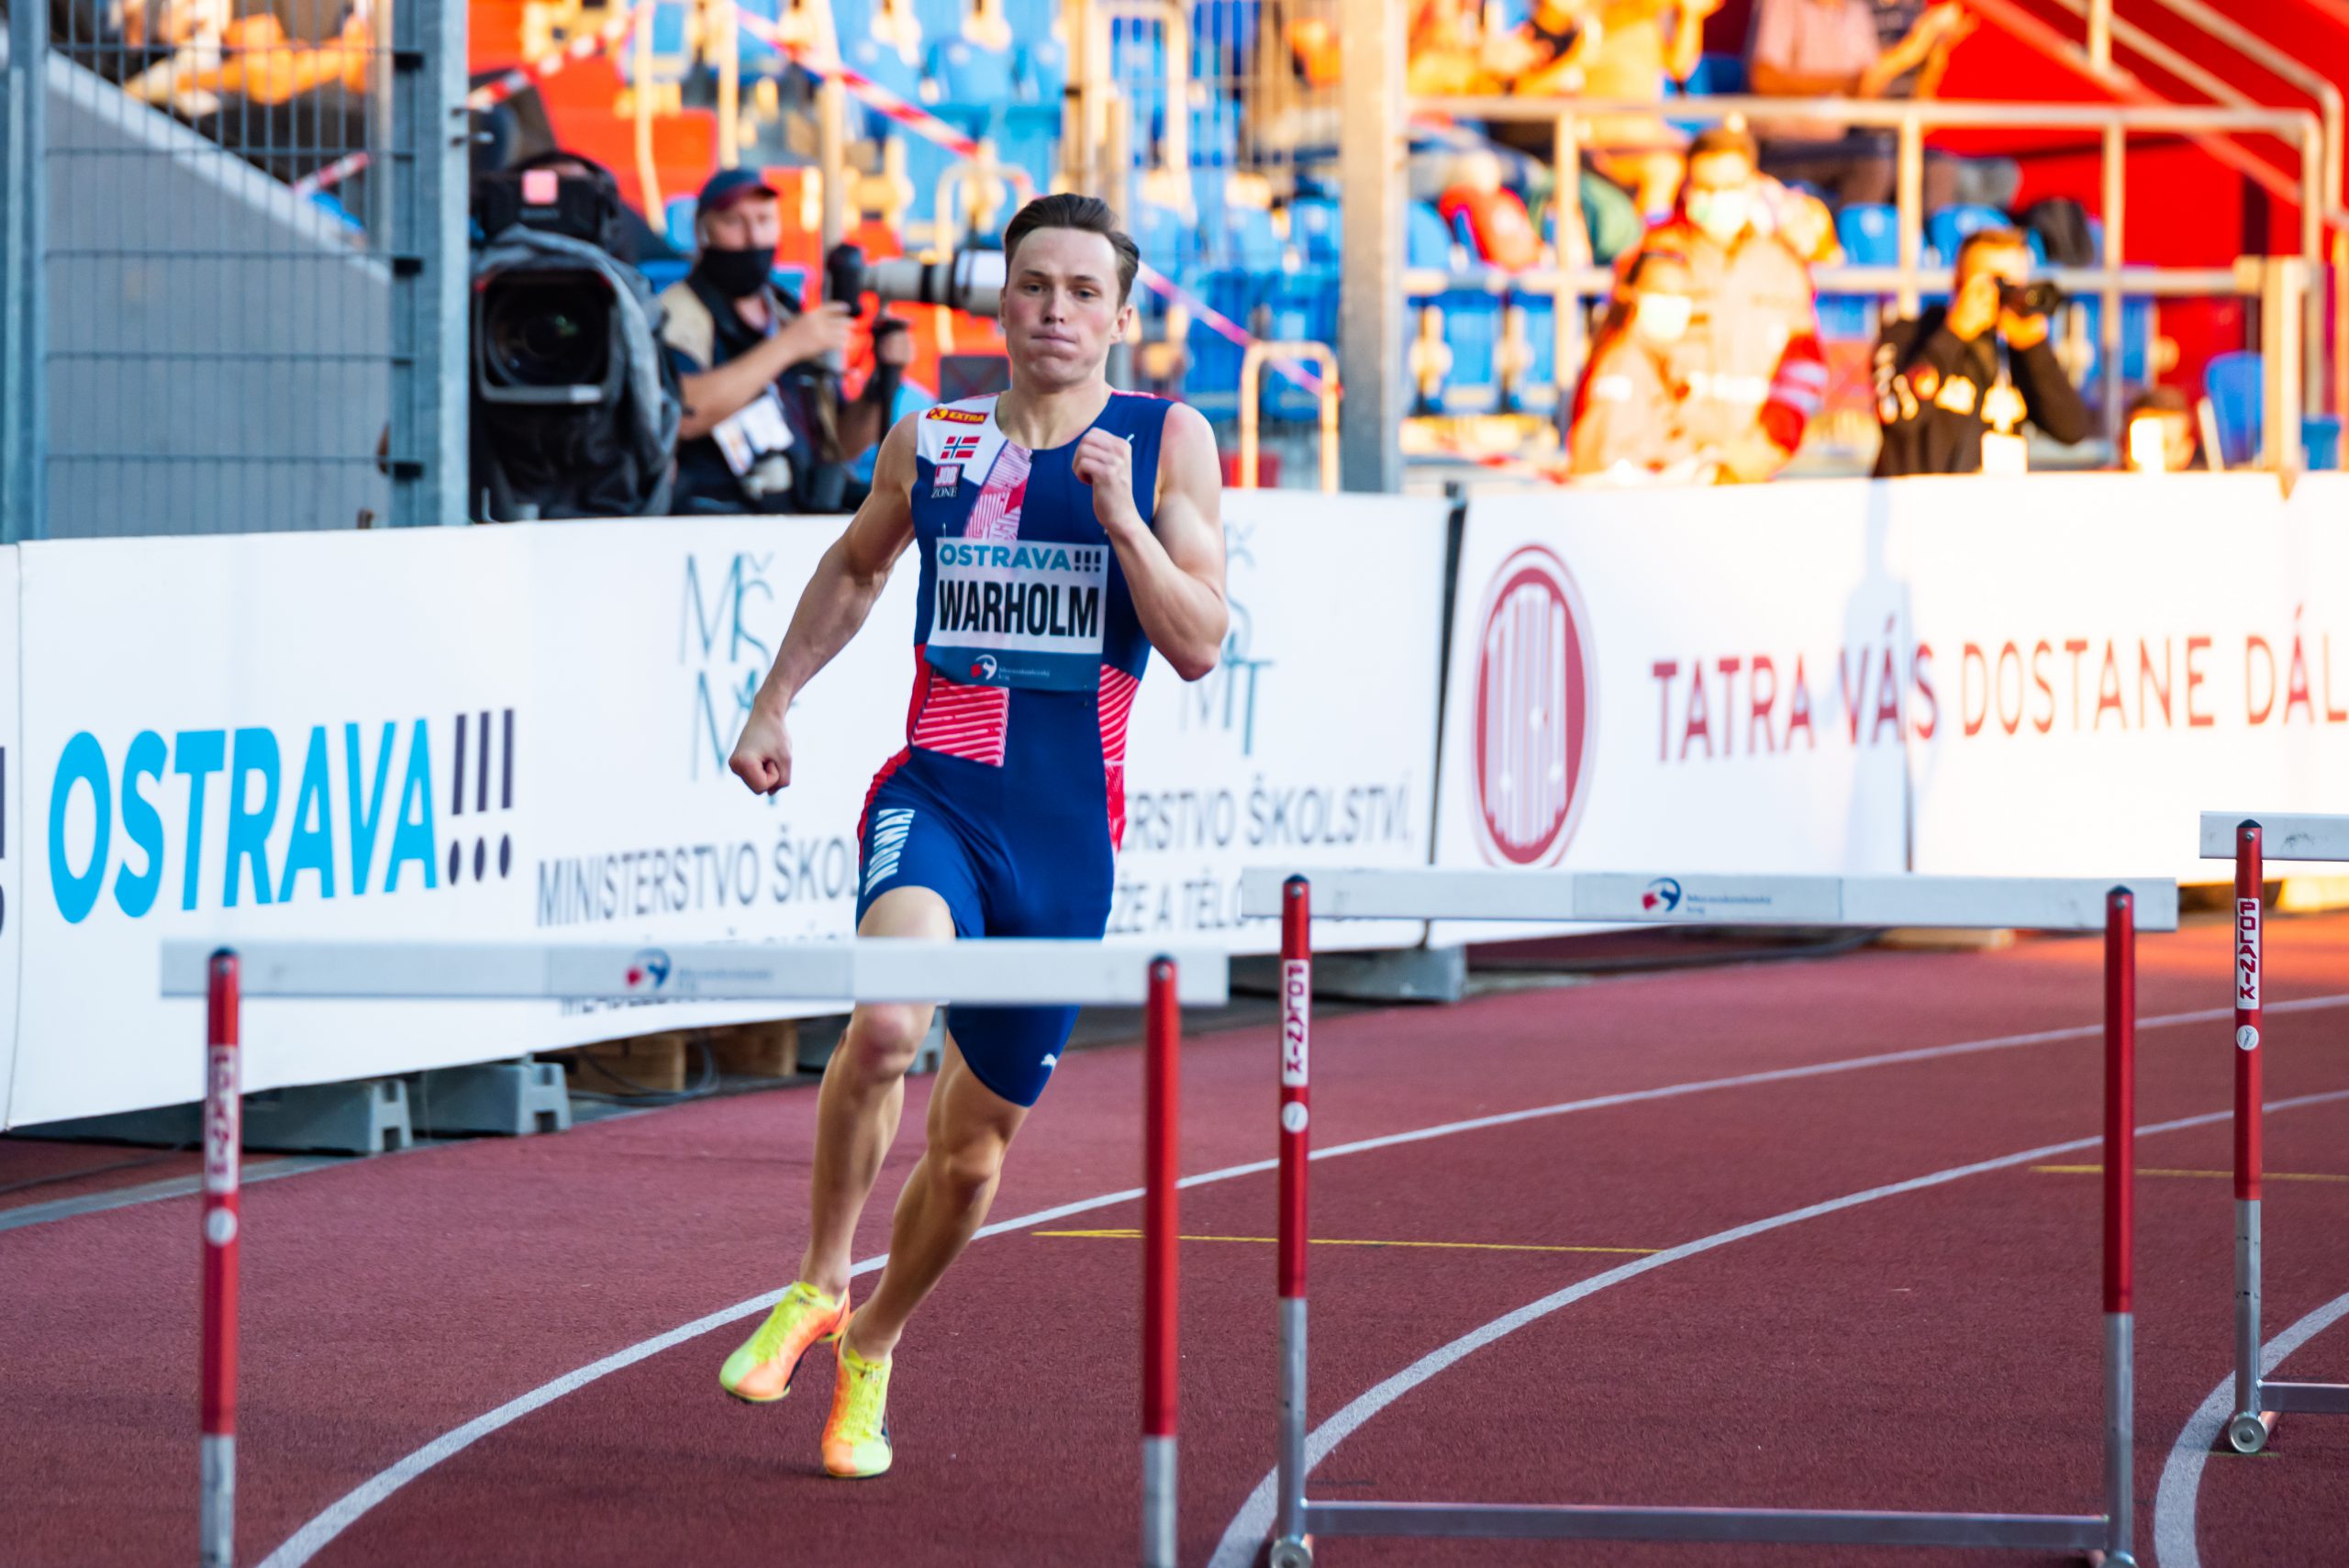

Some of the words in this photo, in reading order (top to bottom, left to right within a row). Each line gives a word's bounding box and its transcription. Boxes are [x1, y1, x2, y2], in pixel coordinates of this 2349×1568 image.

[948, 411, 985, 422] EXTRA
[931, 486, 957, 498] ZONE
[939, 543, 1102, 573] OSTRAVA!!!
[938, 579, 1100, 639] WARHOLM
[1652, 652, 1817, 762] TATRA
[1839, 613, 1940, 747] VÁS
[1962, 635, 2215, 737] DOSTANE
[49, 708, 516, 924] OSTRAVA!!!
[1120, 787, 1236, 851] ERSTVO
[537, 839, 761, 927] MINISTERSTVO
[773, 822, 860, 899] ŠKOL
[2239, 900, 2257, 1000] POLANIK
